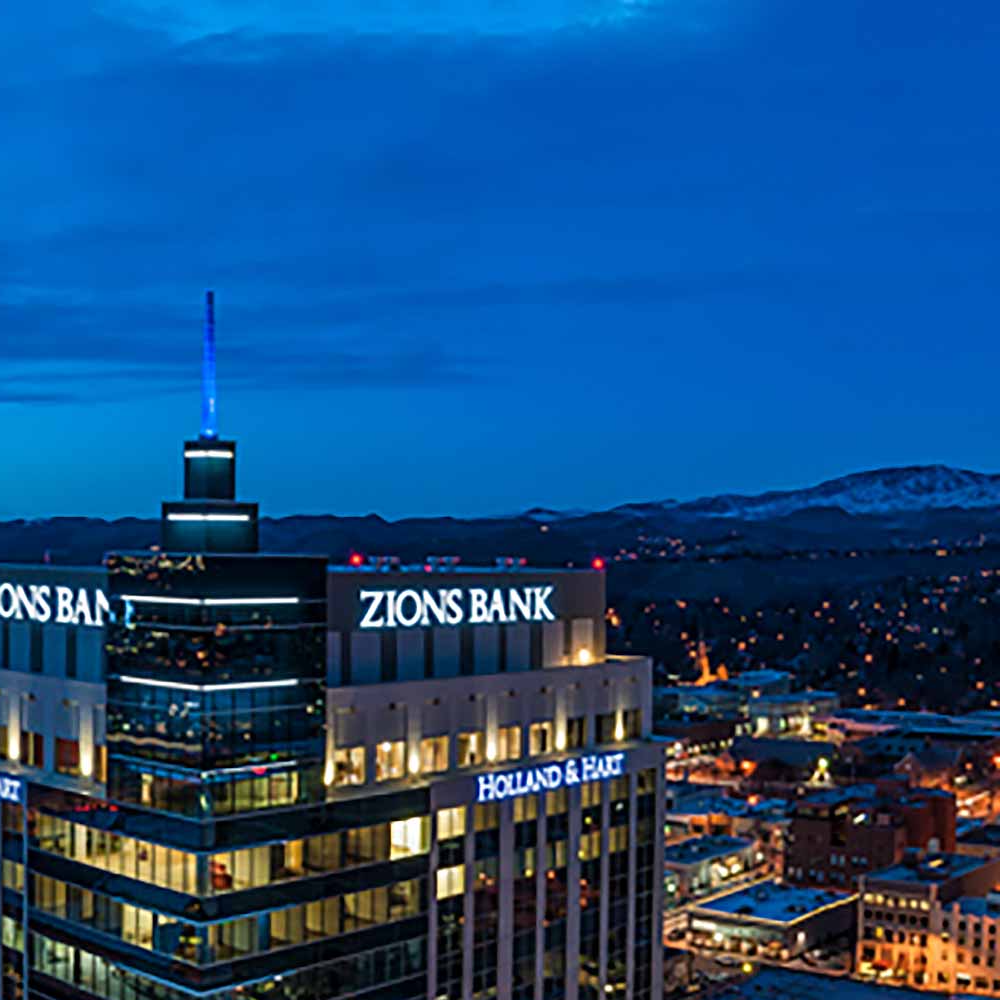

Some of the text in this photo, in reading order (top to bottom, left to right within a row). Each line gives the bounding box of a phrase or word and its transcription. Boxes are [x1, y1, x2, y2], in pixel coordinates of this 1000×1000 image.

[360, 586, 555, 628] ZIONS BANK
[478, 752, 625, 802] HOLLAND & HART
